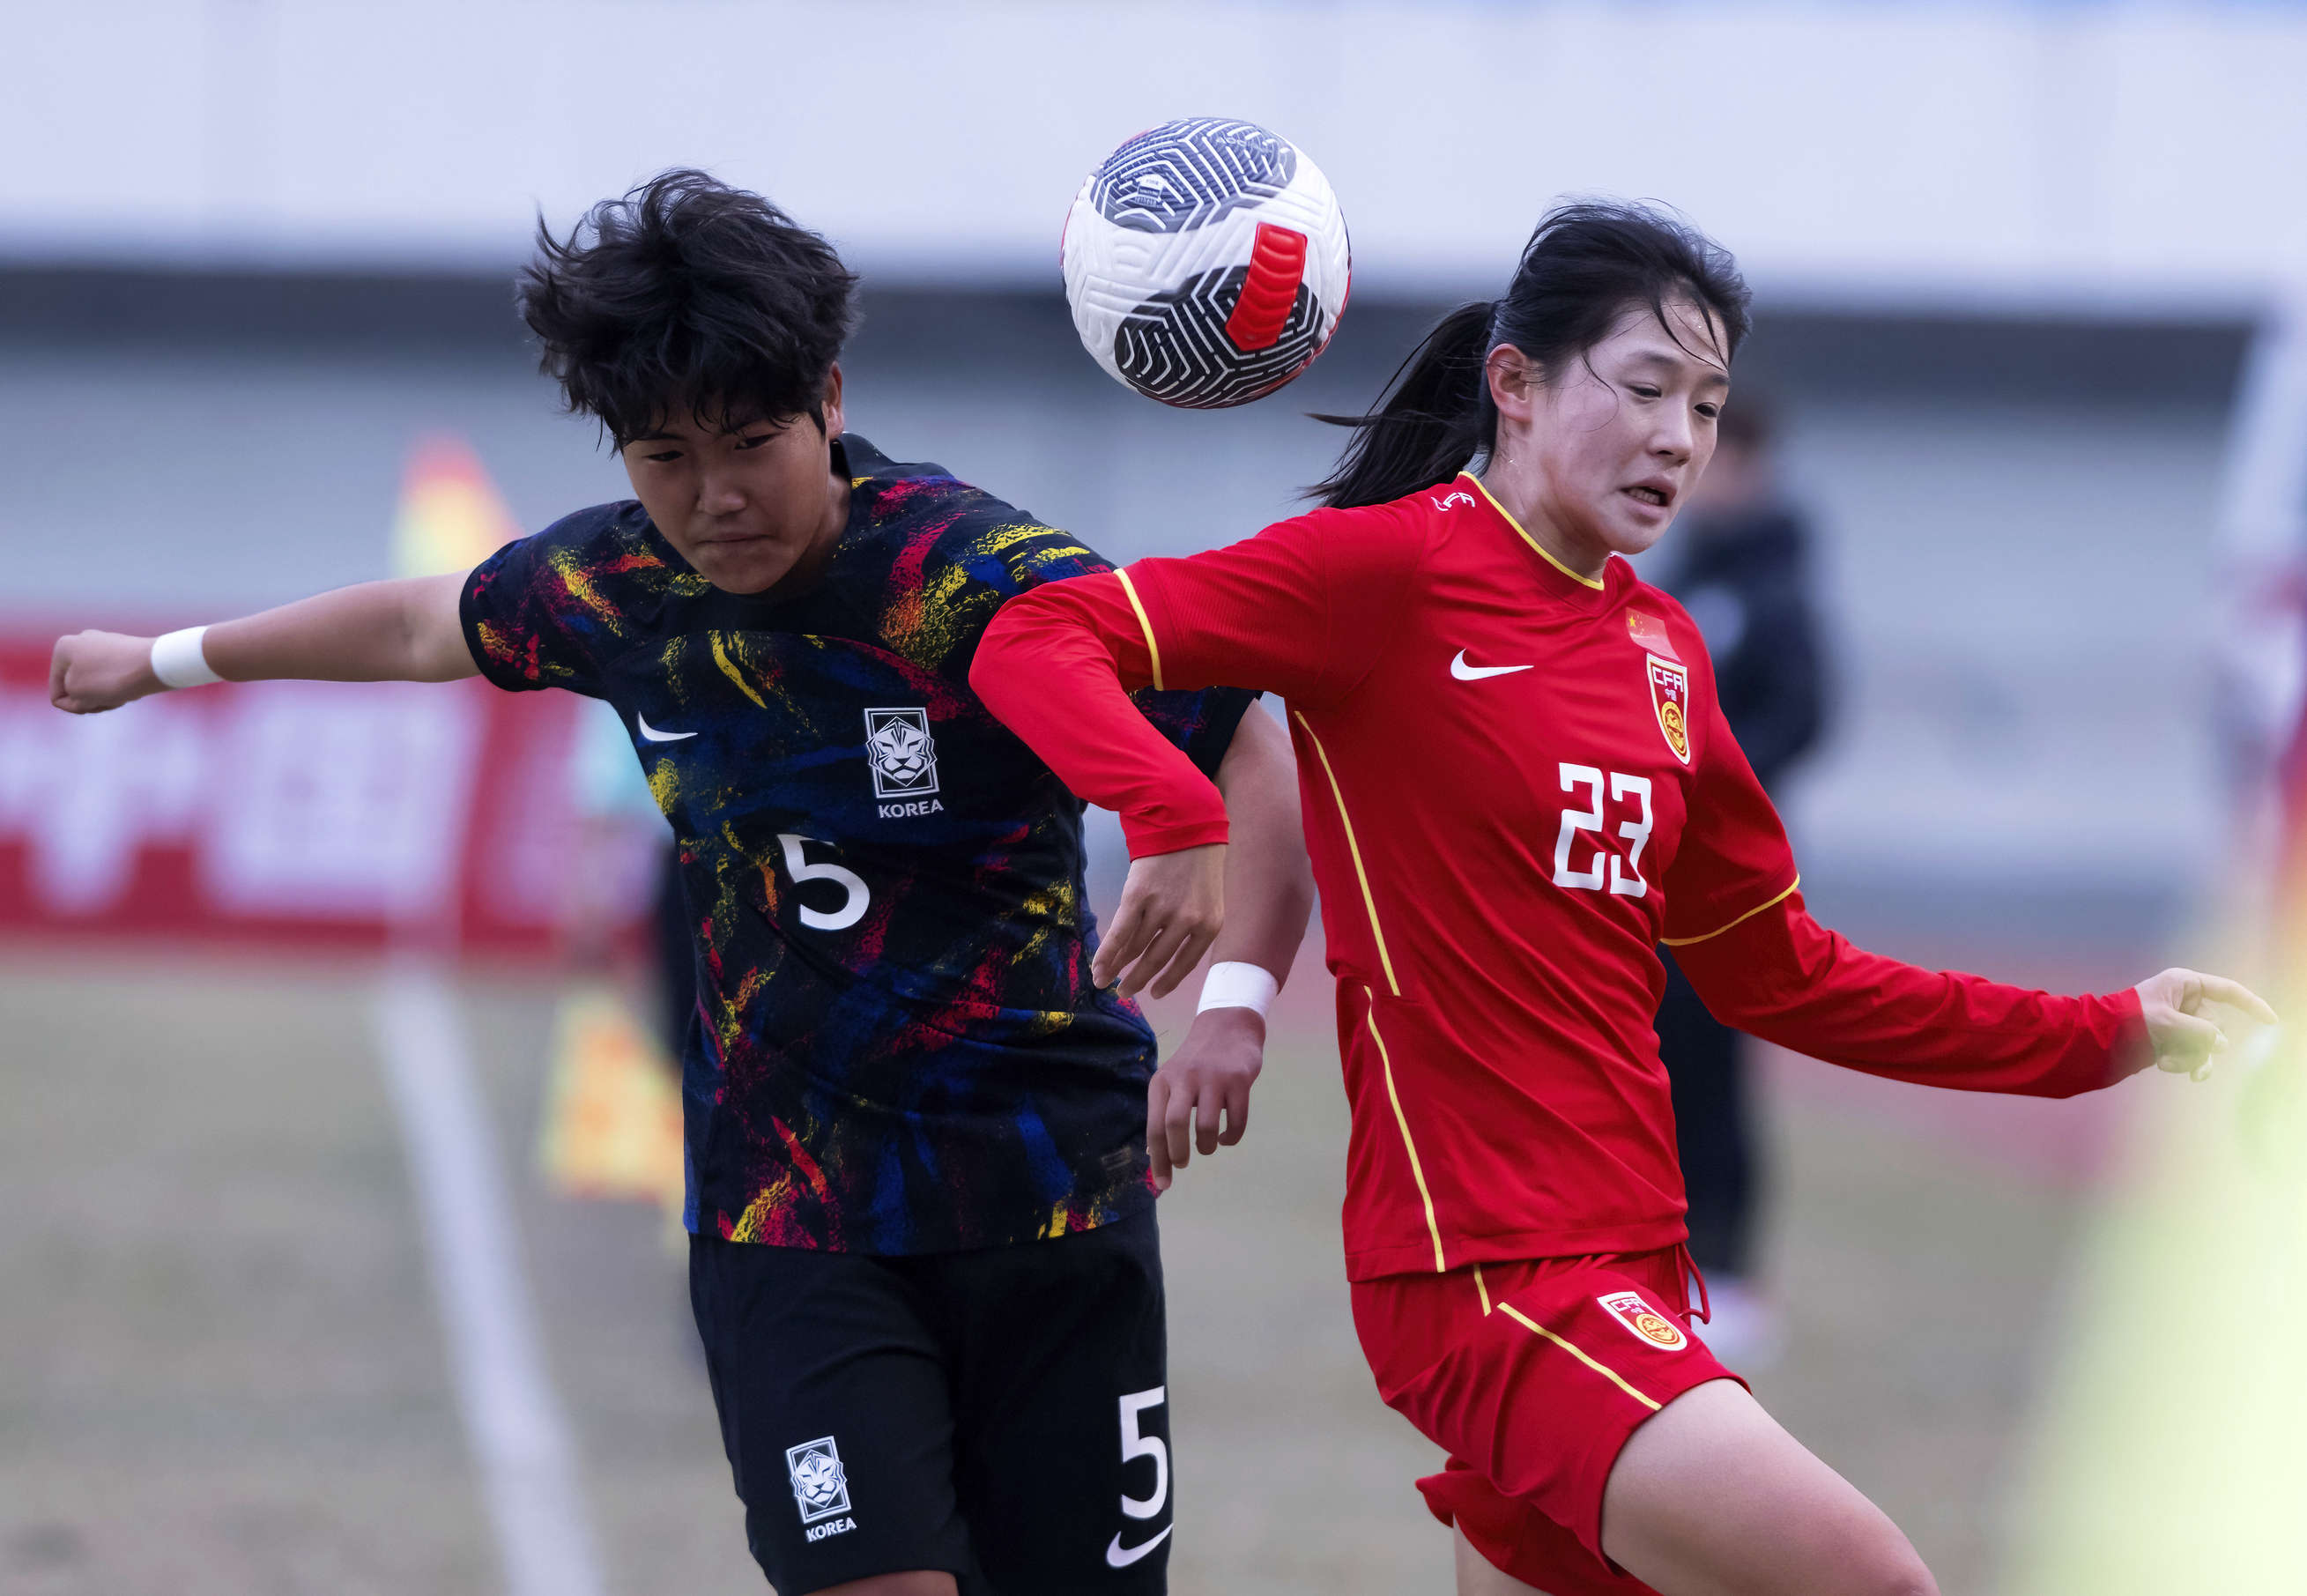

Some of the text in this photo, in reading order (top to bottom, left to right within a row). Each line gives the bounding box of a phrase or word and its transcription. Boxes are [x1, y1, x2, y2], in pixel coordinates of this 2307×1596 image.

[1430, 492, 1475, 512] CFA
[1652, 665, 1684, 693] CFA
[879, 798, 945, 819] KOREA
[1552, 761, 1654, 898] 23
[776, 834, 871, 931] 5
[1609, 1297, 1646, 1312] CFA
[1118, 1385, 1168, 1519] 5
[805, 1517, 857, 1543] KOREA
